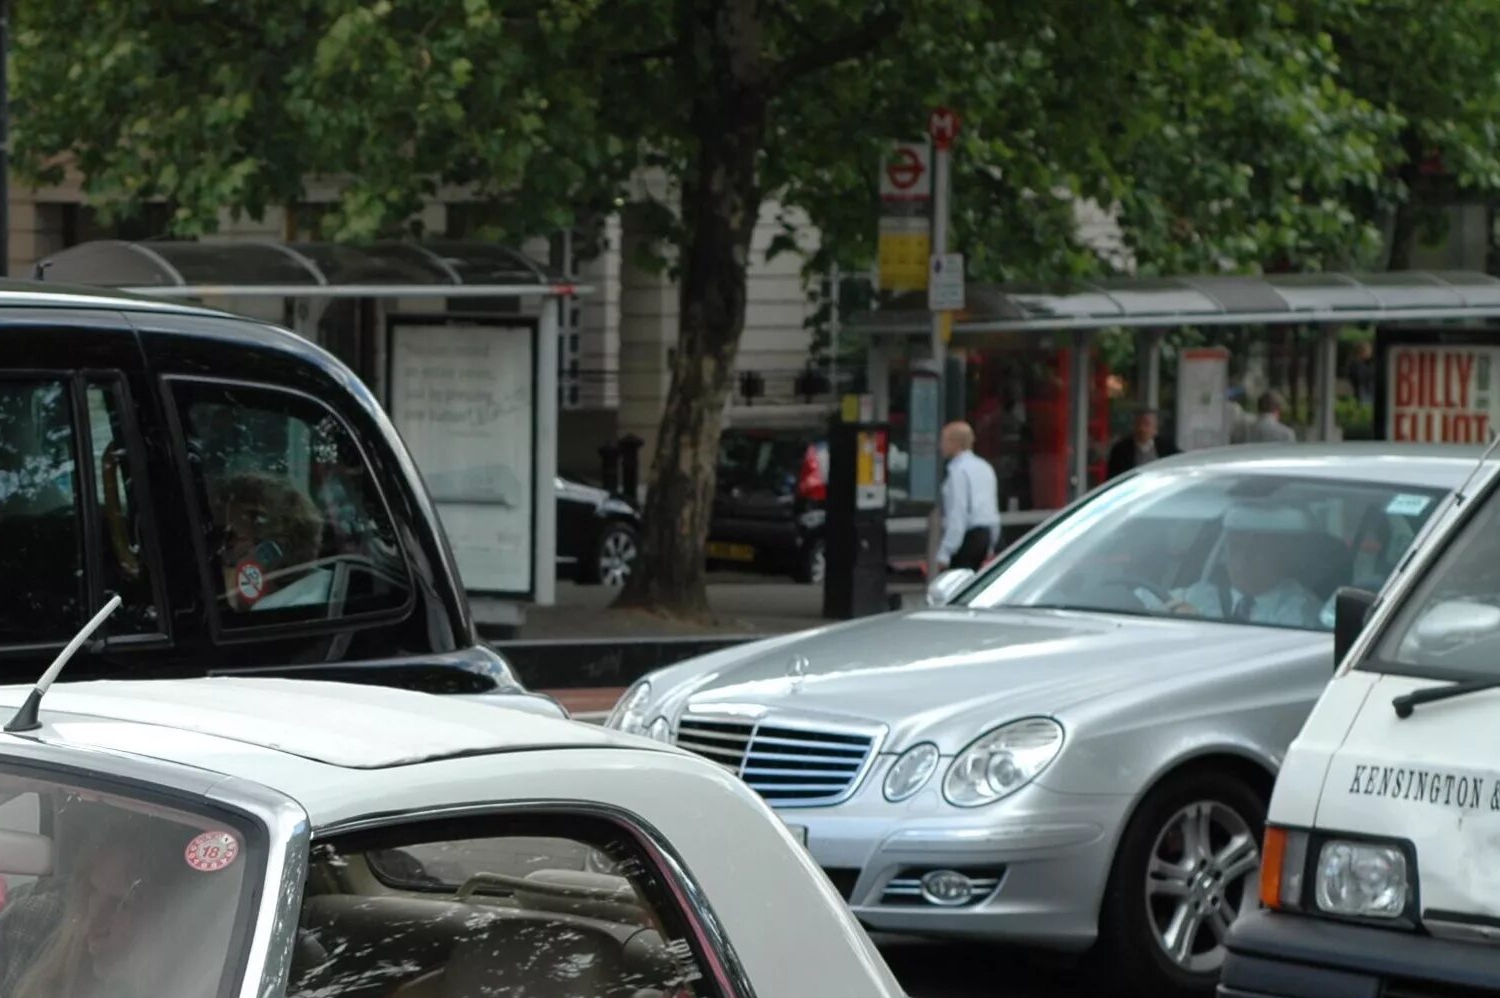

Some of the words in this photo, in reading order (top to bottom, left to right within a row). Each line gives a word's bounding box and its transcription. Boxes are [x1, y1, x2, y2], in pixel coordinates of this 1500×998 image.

[931, 113, 952, 138] M
[1395, 351, 1476, 409] BILLY
[1349, 764, 1484, 809] KENSINGTON
[203, 846, 219, 858] 18
